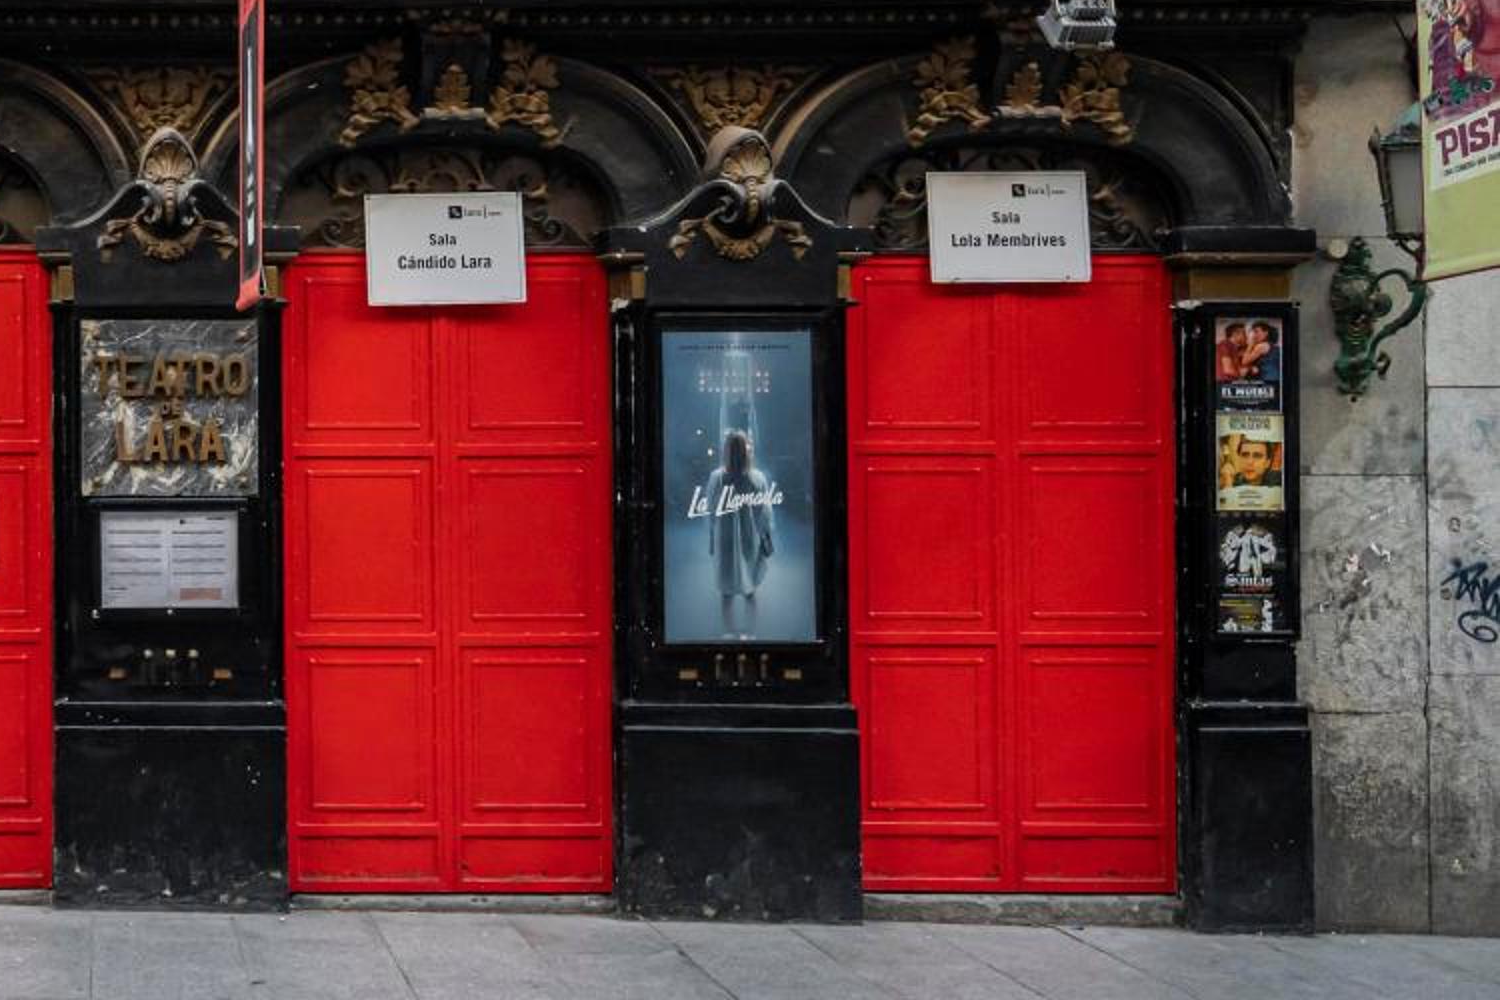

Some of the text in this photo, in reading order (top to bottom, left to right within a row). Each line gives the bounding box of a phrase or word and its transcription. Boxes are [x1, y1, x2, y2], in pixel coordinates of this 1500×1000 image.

[991, 211, 1021, 224] Sala
[429, 233, 457, 246] Sala
[951, 233, 1067, 247] Lola Membrives
[398, 254, 493, 270] Cándido Lara
[93, 352, 251, 402] TEATRO
[115, 416, 227, 467] LARA
[687, 482, 784, 519] La Llamada
